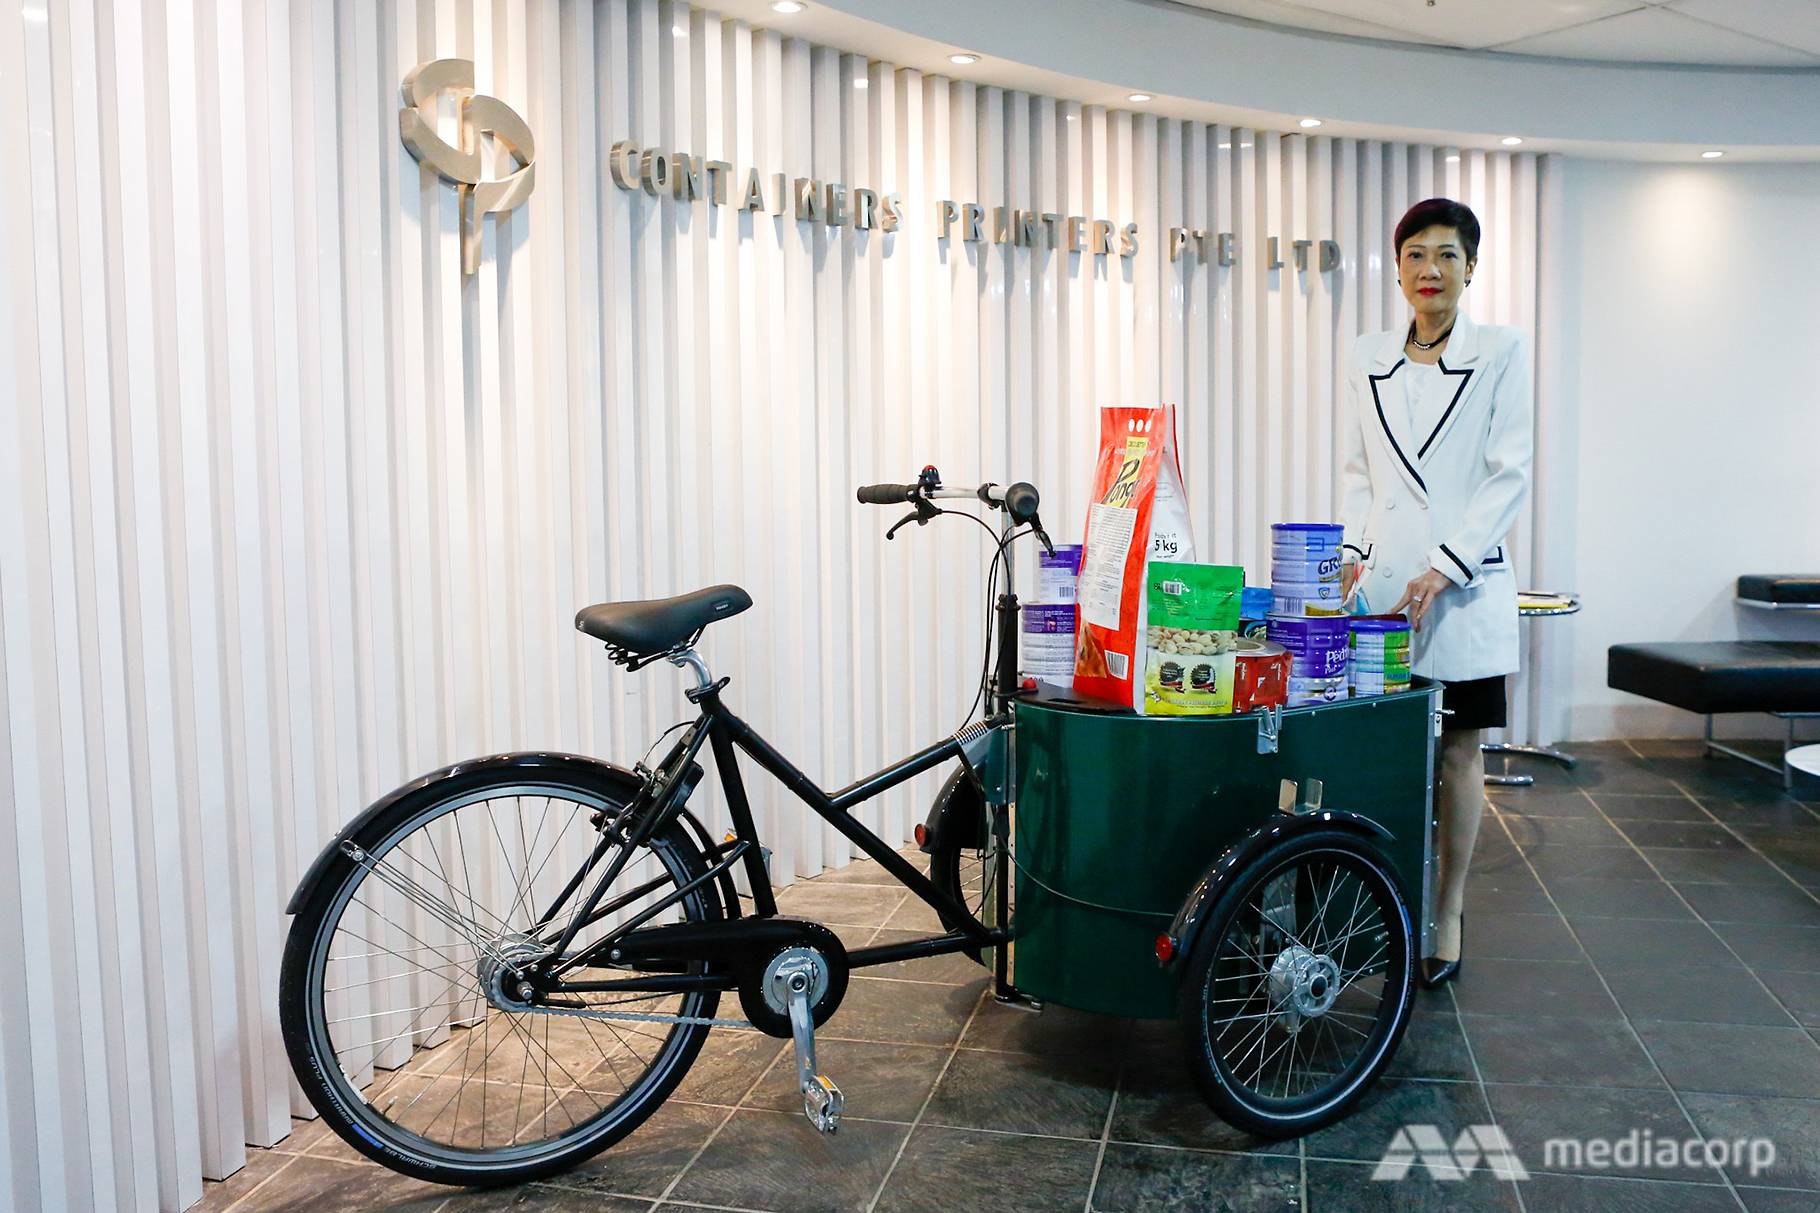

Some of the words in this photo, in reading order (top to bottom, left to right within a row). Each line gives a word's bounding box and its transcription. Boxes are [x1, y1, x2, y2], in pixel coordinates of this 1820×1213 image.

[610, 139, 904, 233] CONTAINERS
[937, 200, 1138, 257] PRINTERS
[1170, 227, 1236, 267] PTE
[1268, 237, 1341, 272] LTD
[1154, 539, 1160, 551] 5
[1162, 539, 1178, 554] kg
